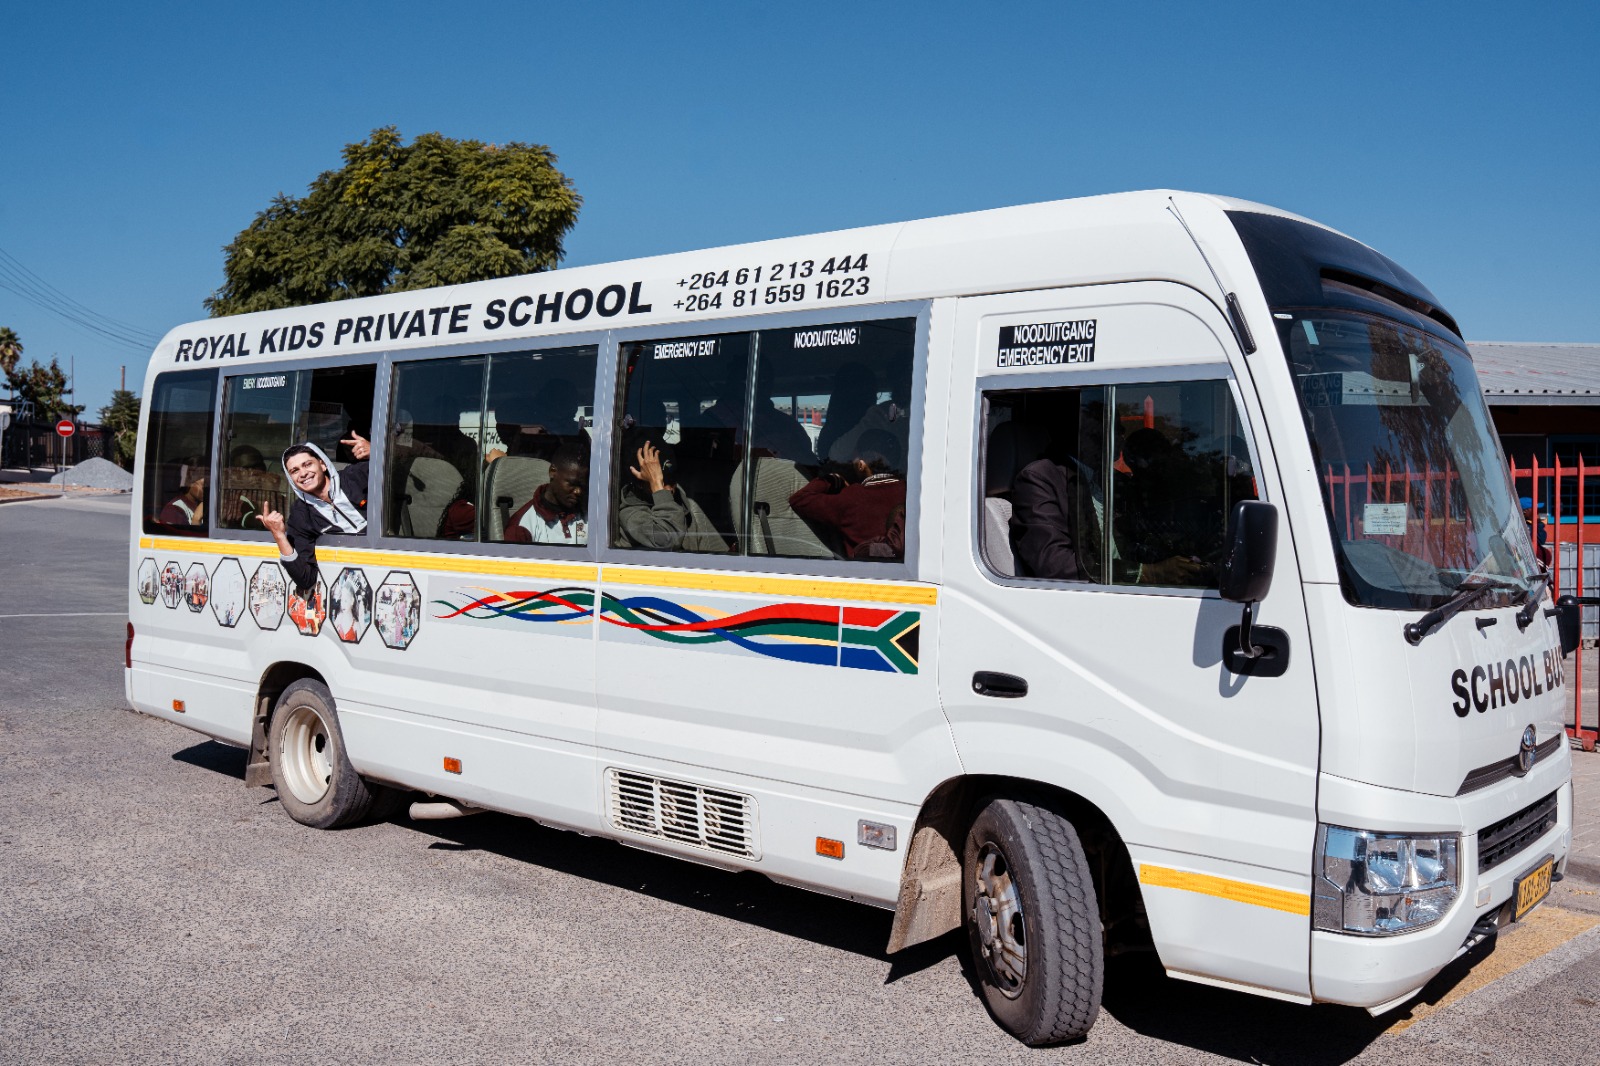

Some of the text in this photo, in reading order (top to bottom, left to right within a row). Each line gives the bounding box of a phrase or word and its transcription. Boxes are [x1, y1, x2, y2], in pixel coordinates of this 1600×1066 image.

[676, 253, 869, 291] +264 61 213 444
[673, 276, 870, 312] +264 81 559 1623
[174, 281, 652, 363] ROYAL KIDS PRIVATE SCHOOL
[1013, 320, 1095, 344] NOODUITGANG
[653, 339, 716, 360] EMERGENCY EXIT
[793, 327, 857, 348] NOODUITGANG
[998, 343, 1093, 367] EMERGENCY EXIT
[1451, 653, 1543, 718] SCHOOL
